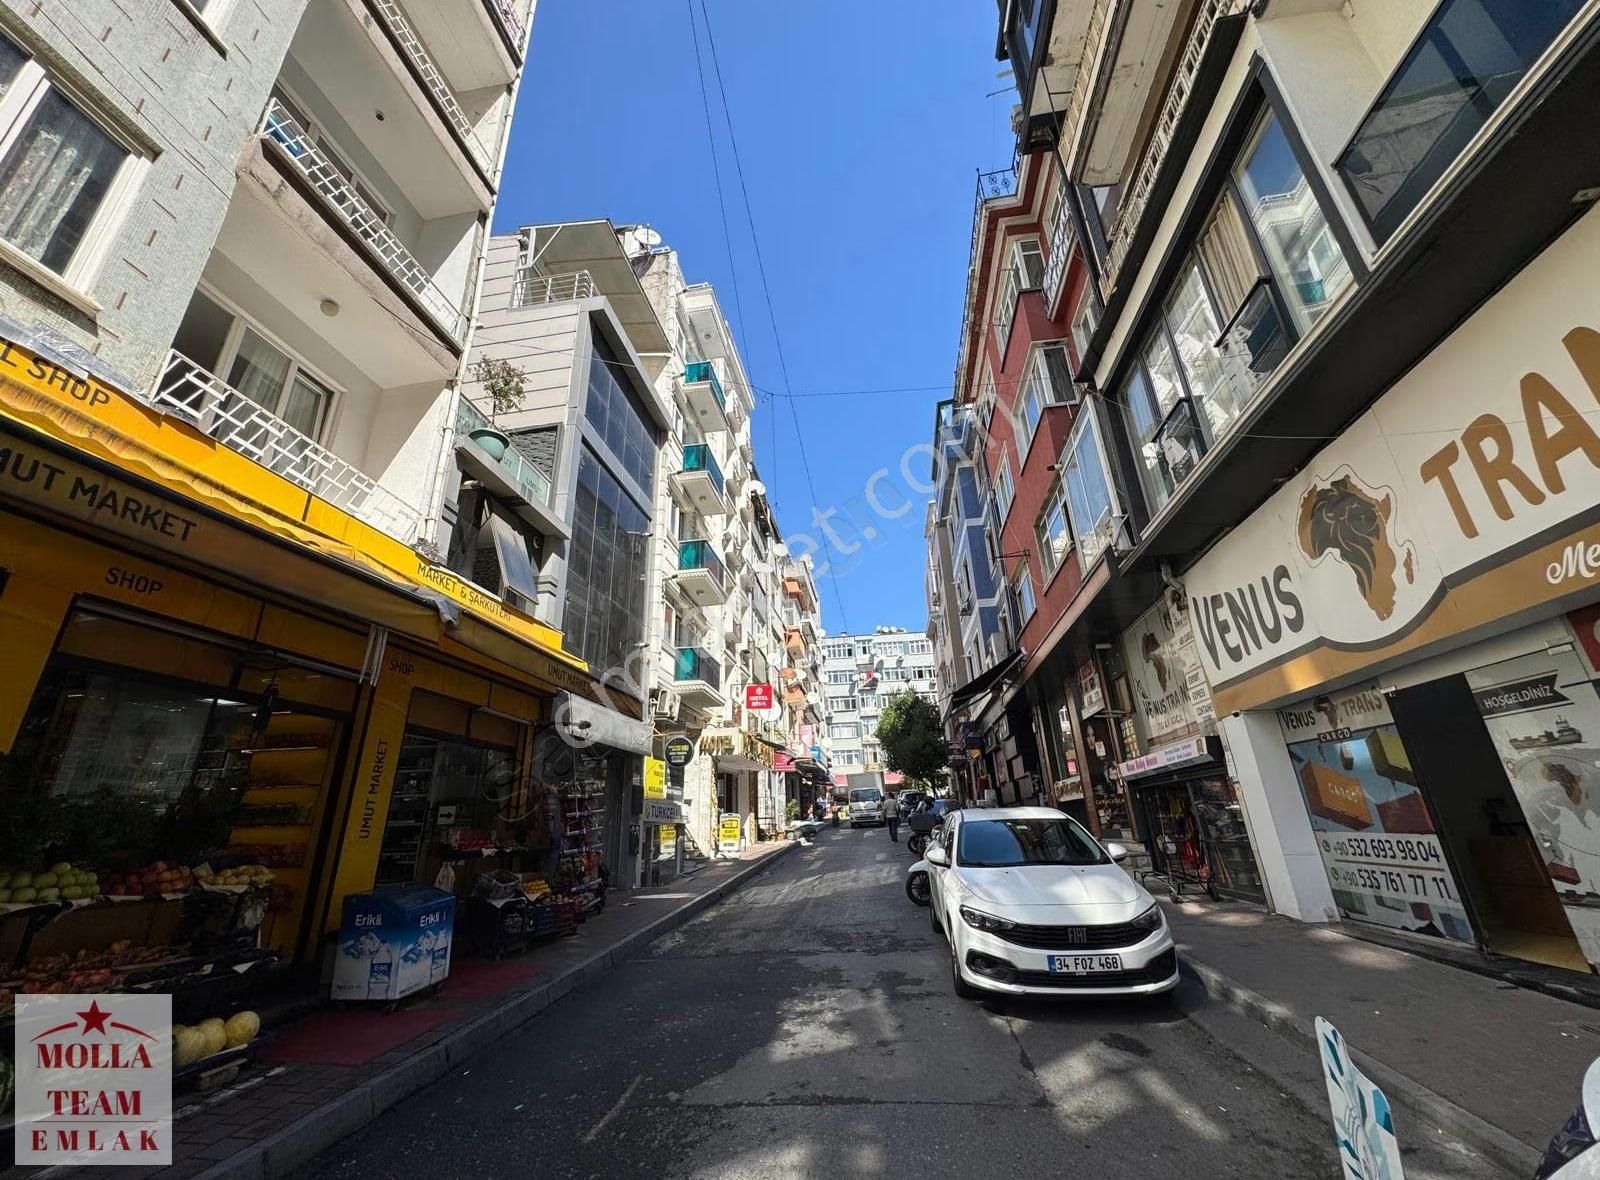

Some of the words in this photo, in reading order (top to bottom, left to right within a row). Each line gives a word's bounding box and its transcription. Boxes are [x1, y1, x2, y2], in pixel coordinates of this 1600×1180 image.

[27, 357, 111, 408] SHOP
[69, 477, 197, 542] MARKET
[105, 567, 163, 596] SHOP
[417, 562, 457, 593] MARKET
[460, 586, 467, 599] &
[1191, 564, 1304, 671] VENUS
[390, 659, 415, 675] SHOP
[548, 662, 567, 682] UMUT
[1483, 684, 1553, 709] HOŞGELDİNİZ
[1143, 698, 1167, 719] VENUS
[1282, 710, 1316, 731] VENUS
[1341, 687, 1383, 717] TRANS
[700, 735, 734, 751] HOTEL
[1320, 729, 1351, 742] CARGO
[360, 799, 376, 839] UMUT
[370, 738, 389, 794] MARKET
[1327, 782, 1358, 803] CARGO
[1333, 840, 1349, 856] +90
[1347, 838, 1371, 857] 532
[1370, 839, 1396, 859] 693
[1342, 871, 1359, 887] +90
[1357, 868, 1380, 889] 535
[1380, 871, 1406, 893] 761
[1408, 874, 1428, 896] 77
[1432, 877, 1452, 900] 11
[355, 914, 382, 927] Erikli
[1068, 927, 1088, 944] FIAT
[1056, 957, 1071, 971] 34
[1074, 956, 1094, 970] FOZ
[1099, 955, 1119, 970] 468
